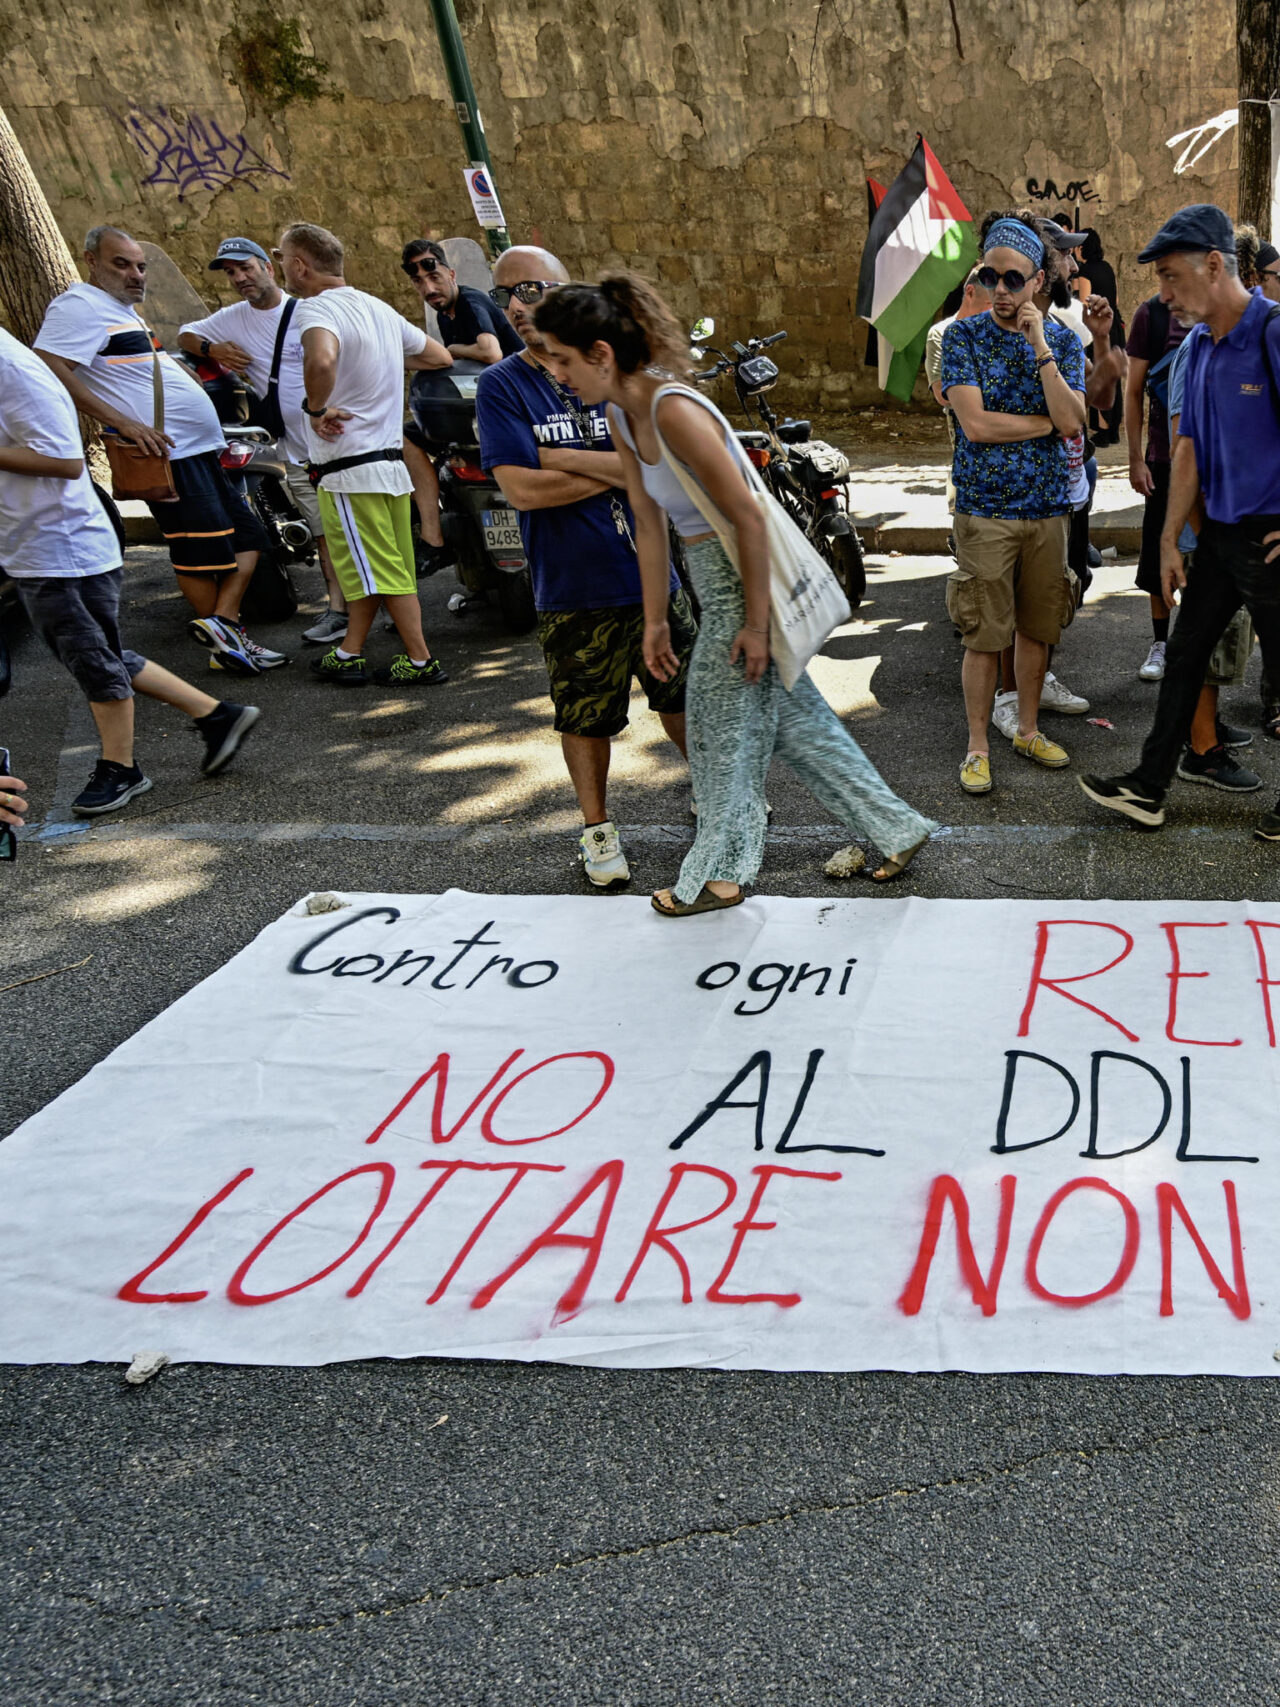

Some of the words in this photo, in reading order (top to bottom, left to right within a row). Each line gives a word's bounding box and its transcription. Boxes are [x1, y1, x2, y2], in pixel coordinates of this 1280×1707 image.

[532, 420, 575, 444] MTN
[486, 529, 521, 546] 9483
[491, 510, 510, 527] DH
[288, 906, 559, 991] Contro
[696, 957, 858, 1016] ogni
[365, 1048, 615, 1145] NO
[669, 1048, 886, 1157] AL
[990, 1050, 1260, 1164] DDL
[117, 1159, 843, 1318] LOTTARE
[898, 1174, 1252, 1321] NON
